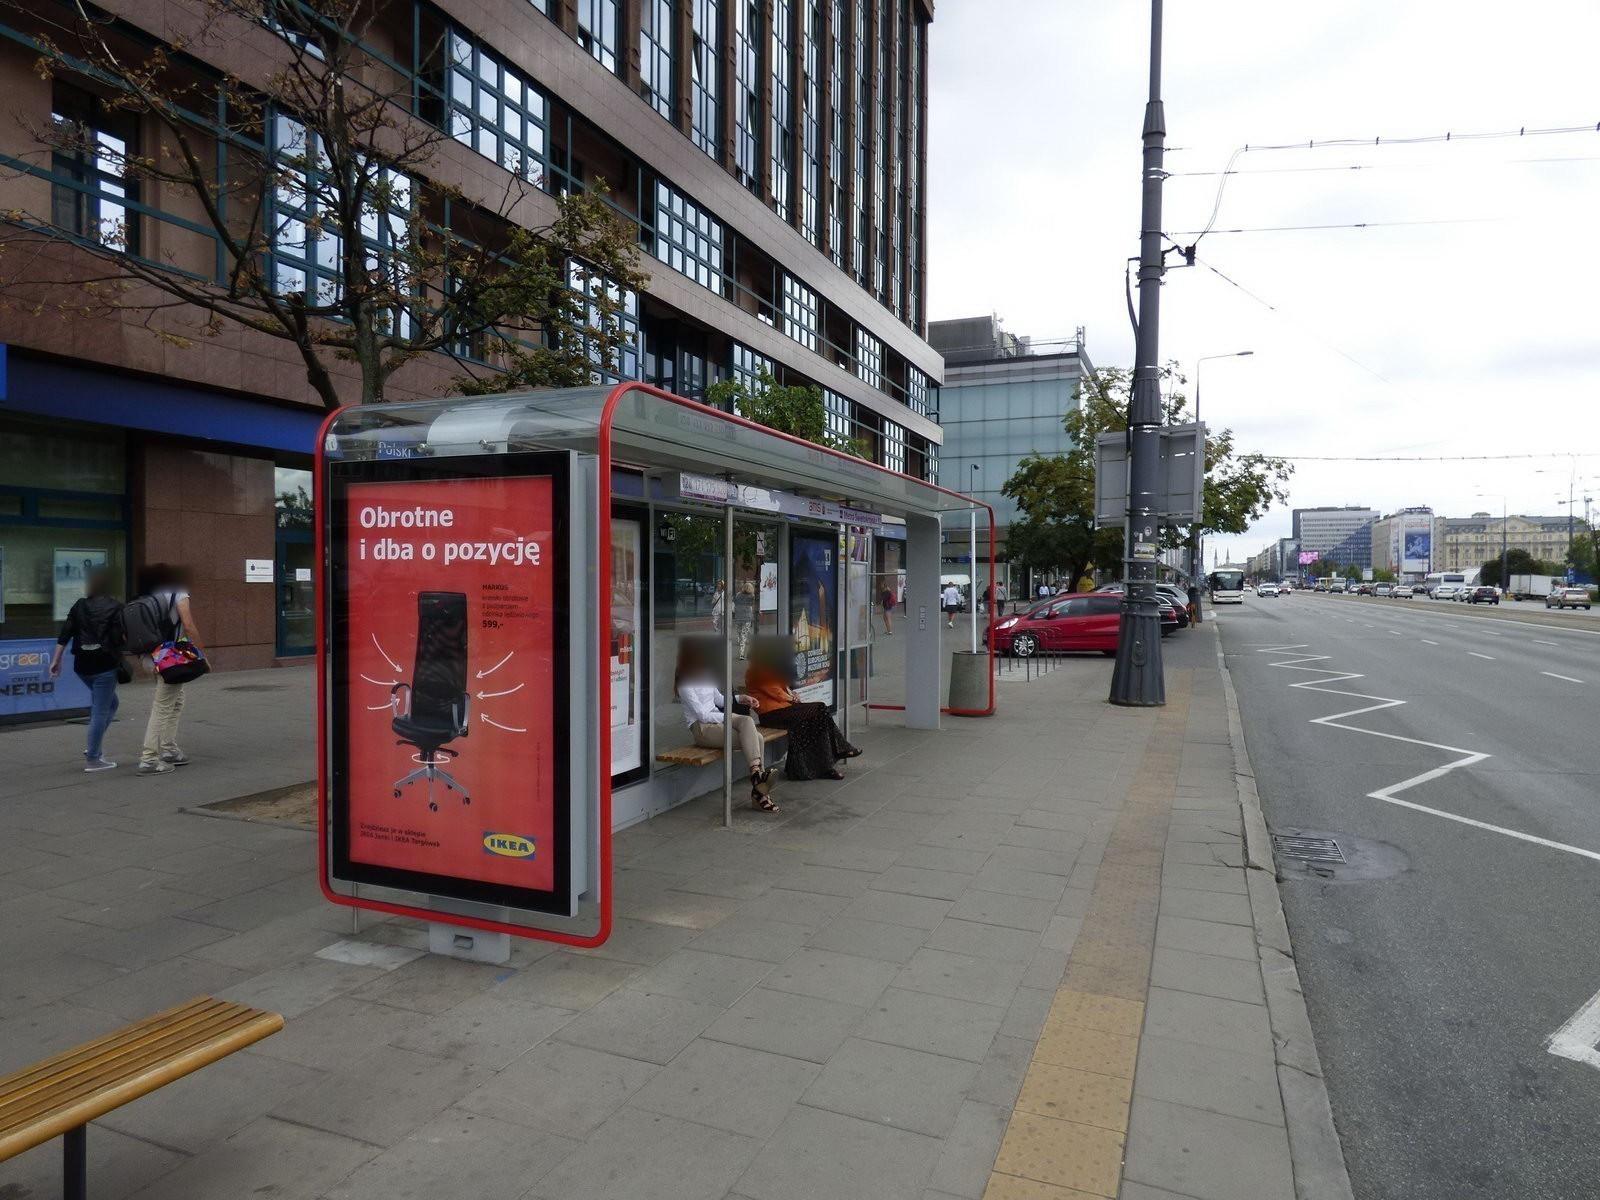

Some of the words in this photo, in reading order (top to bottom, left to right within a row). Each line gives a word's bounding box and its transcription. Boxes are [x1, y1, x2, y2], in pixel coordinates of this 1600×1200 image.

[360, 506, 453, 528] Obrotne
[360, 538, 366, 560] i
[373, 538, 413, 560] dba
[422, 542, 436, 560] o
[444, 536, 540, 566] pozycję
[0, 652, 51, 670] green
[491, 838, 530, 852] IKEA
